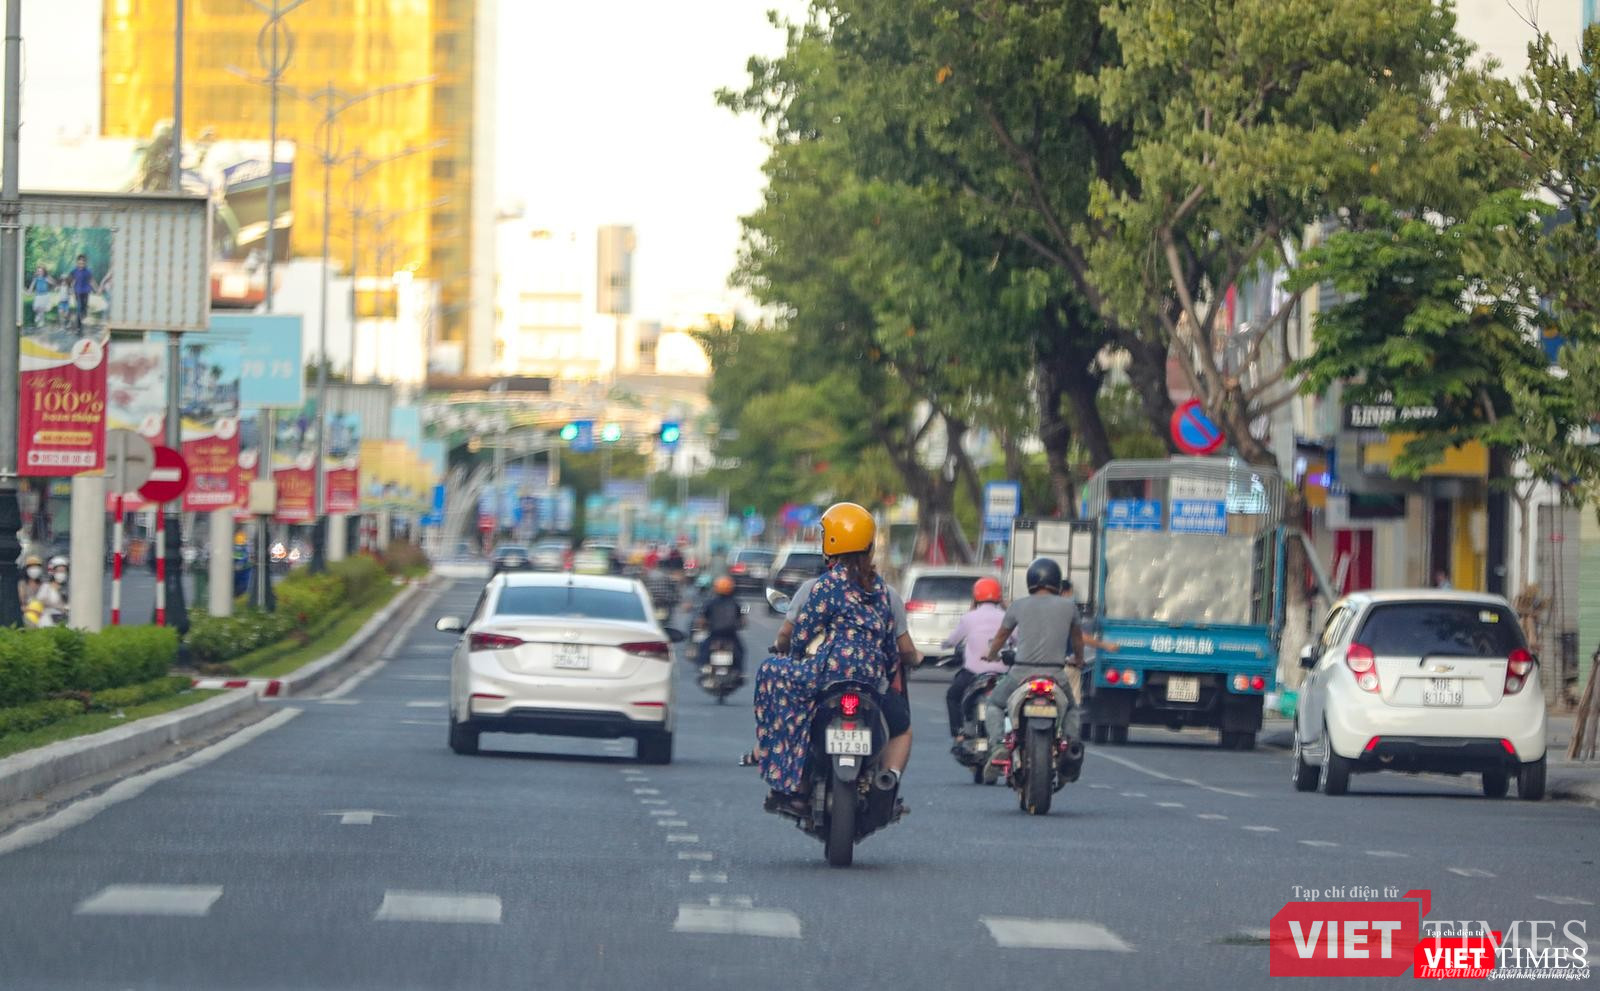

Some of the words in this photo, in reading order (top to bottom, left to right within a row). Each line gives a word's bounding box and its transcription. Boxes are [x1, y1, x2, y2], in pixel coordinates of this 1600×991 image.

[34, 390, 104, 413] 100%
[833, 730, 864, 741] 43-F1
[830, 742, 869, 753] 112.90
